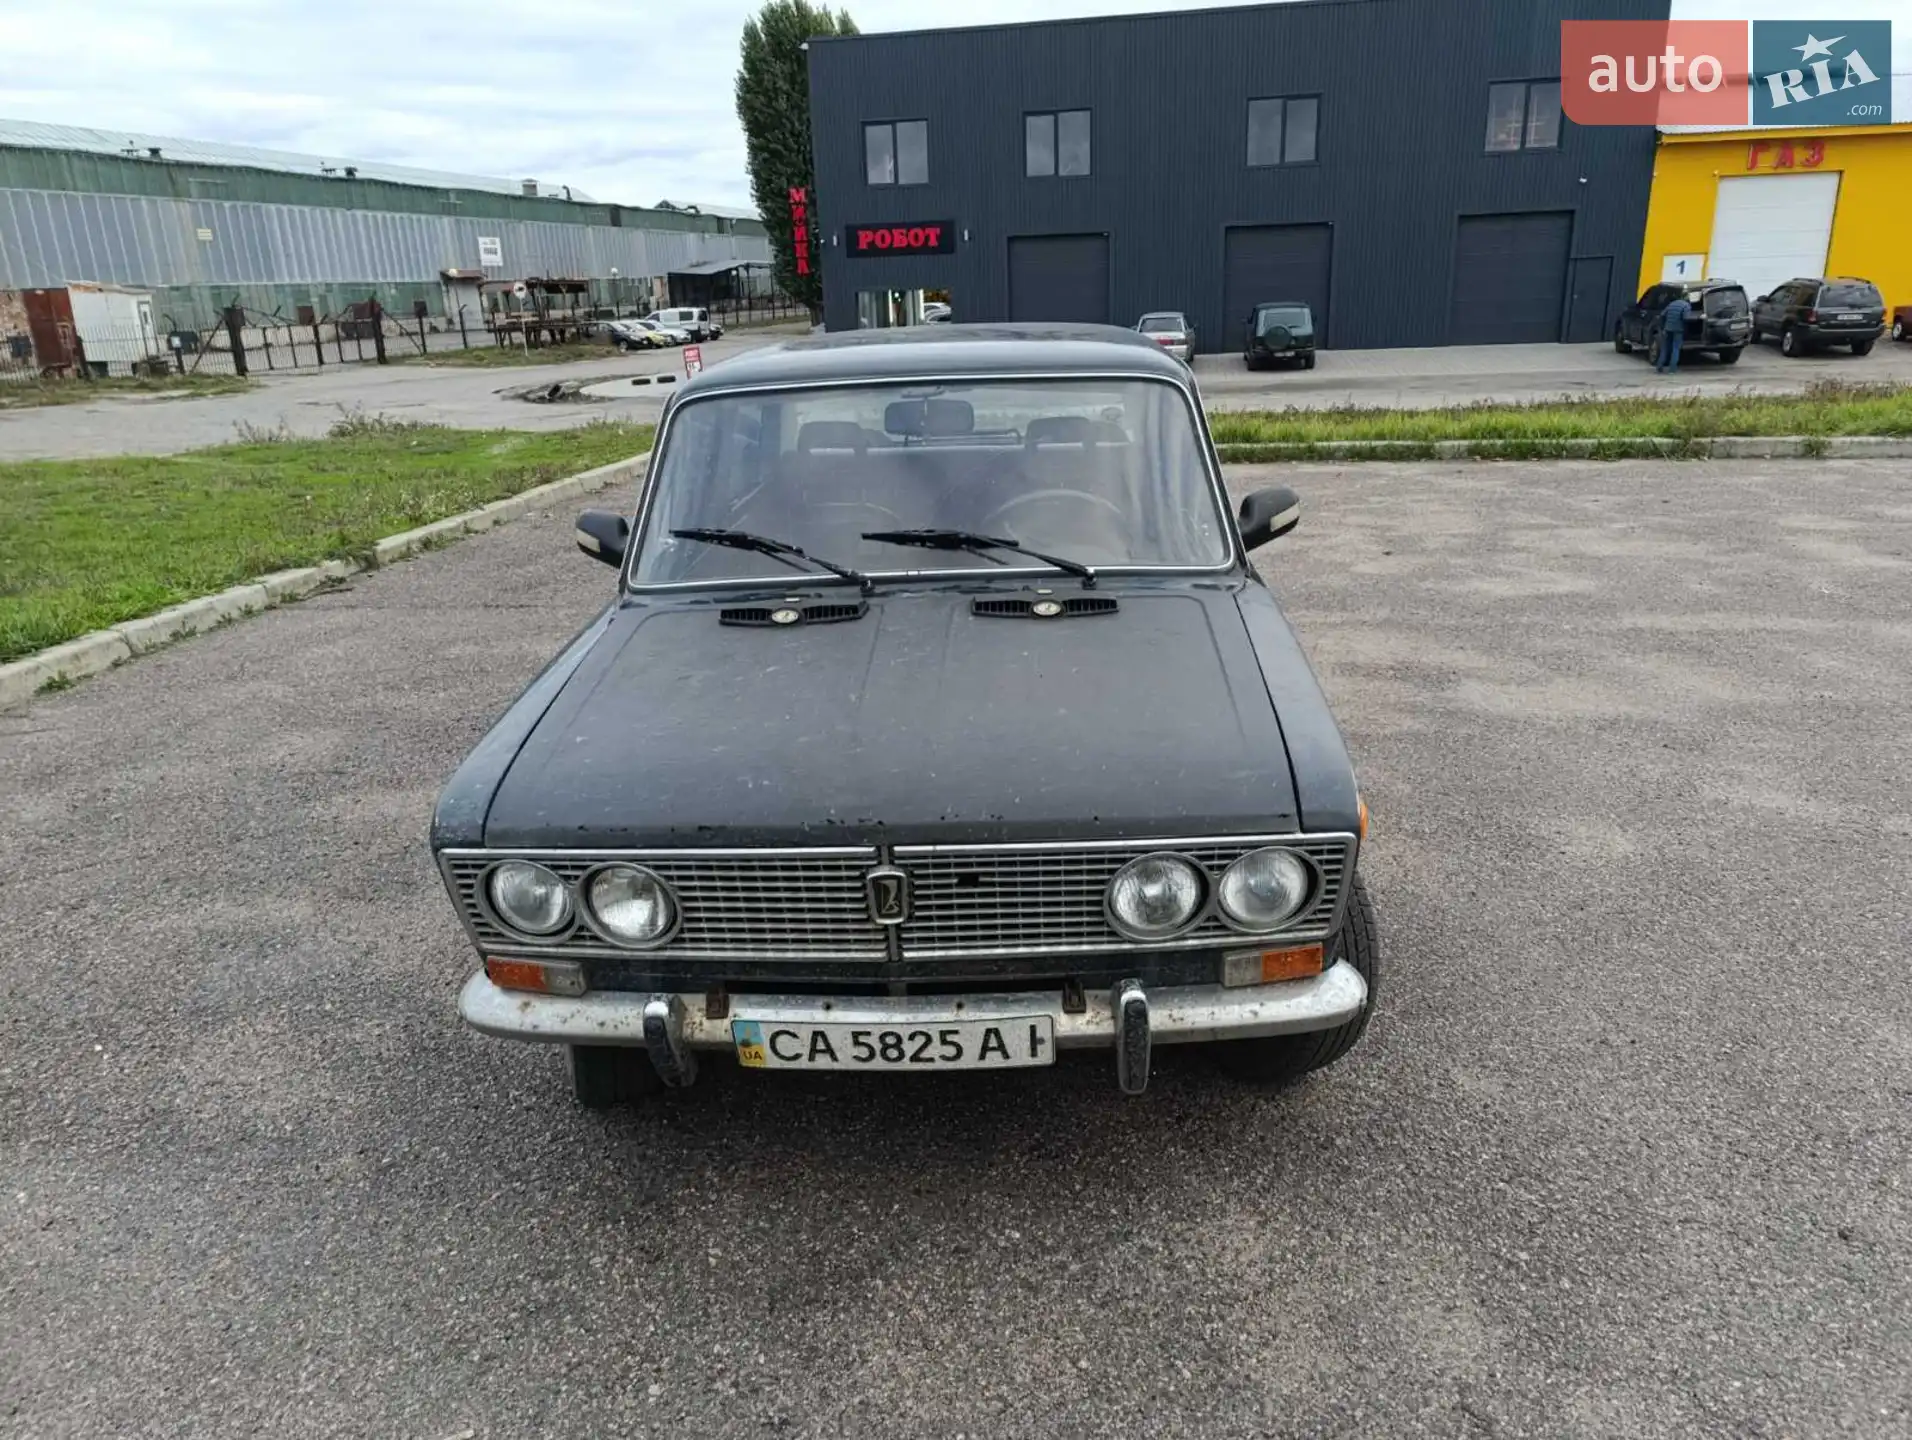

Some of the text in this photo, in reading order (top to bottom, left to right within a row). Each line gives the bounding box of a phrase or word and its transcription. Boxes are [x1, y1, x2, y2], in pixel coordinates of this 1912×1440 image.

[1747, 140, 1826, 170] ГАЗ
[857, 227, 941, 249] РОБОТ
[1675, 260, 1687, 276] 1
[743, 1051, 762, 1061] UA
[851, 1029, 963, 1062] 5825
